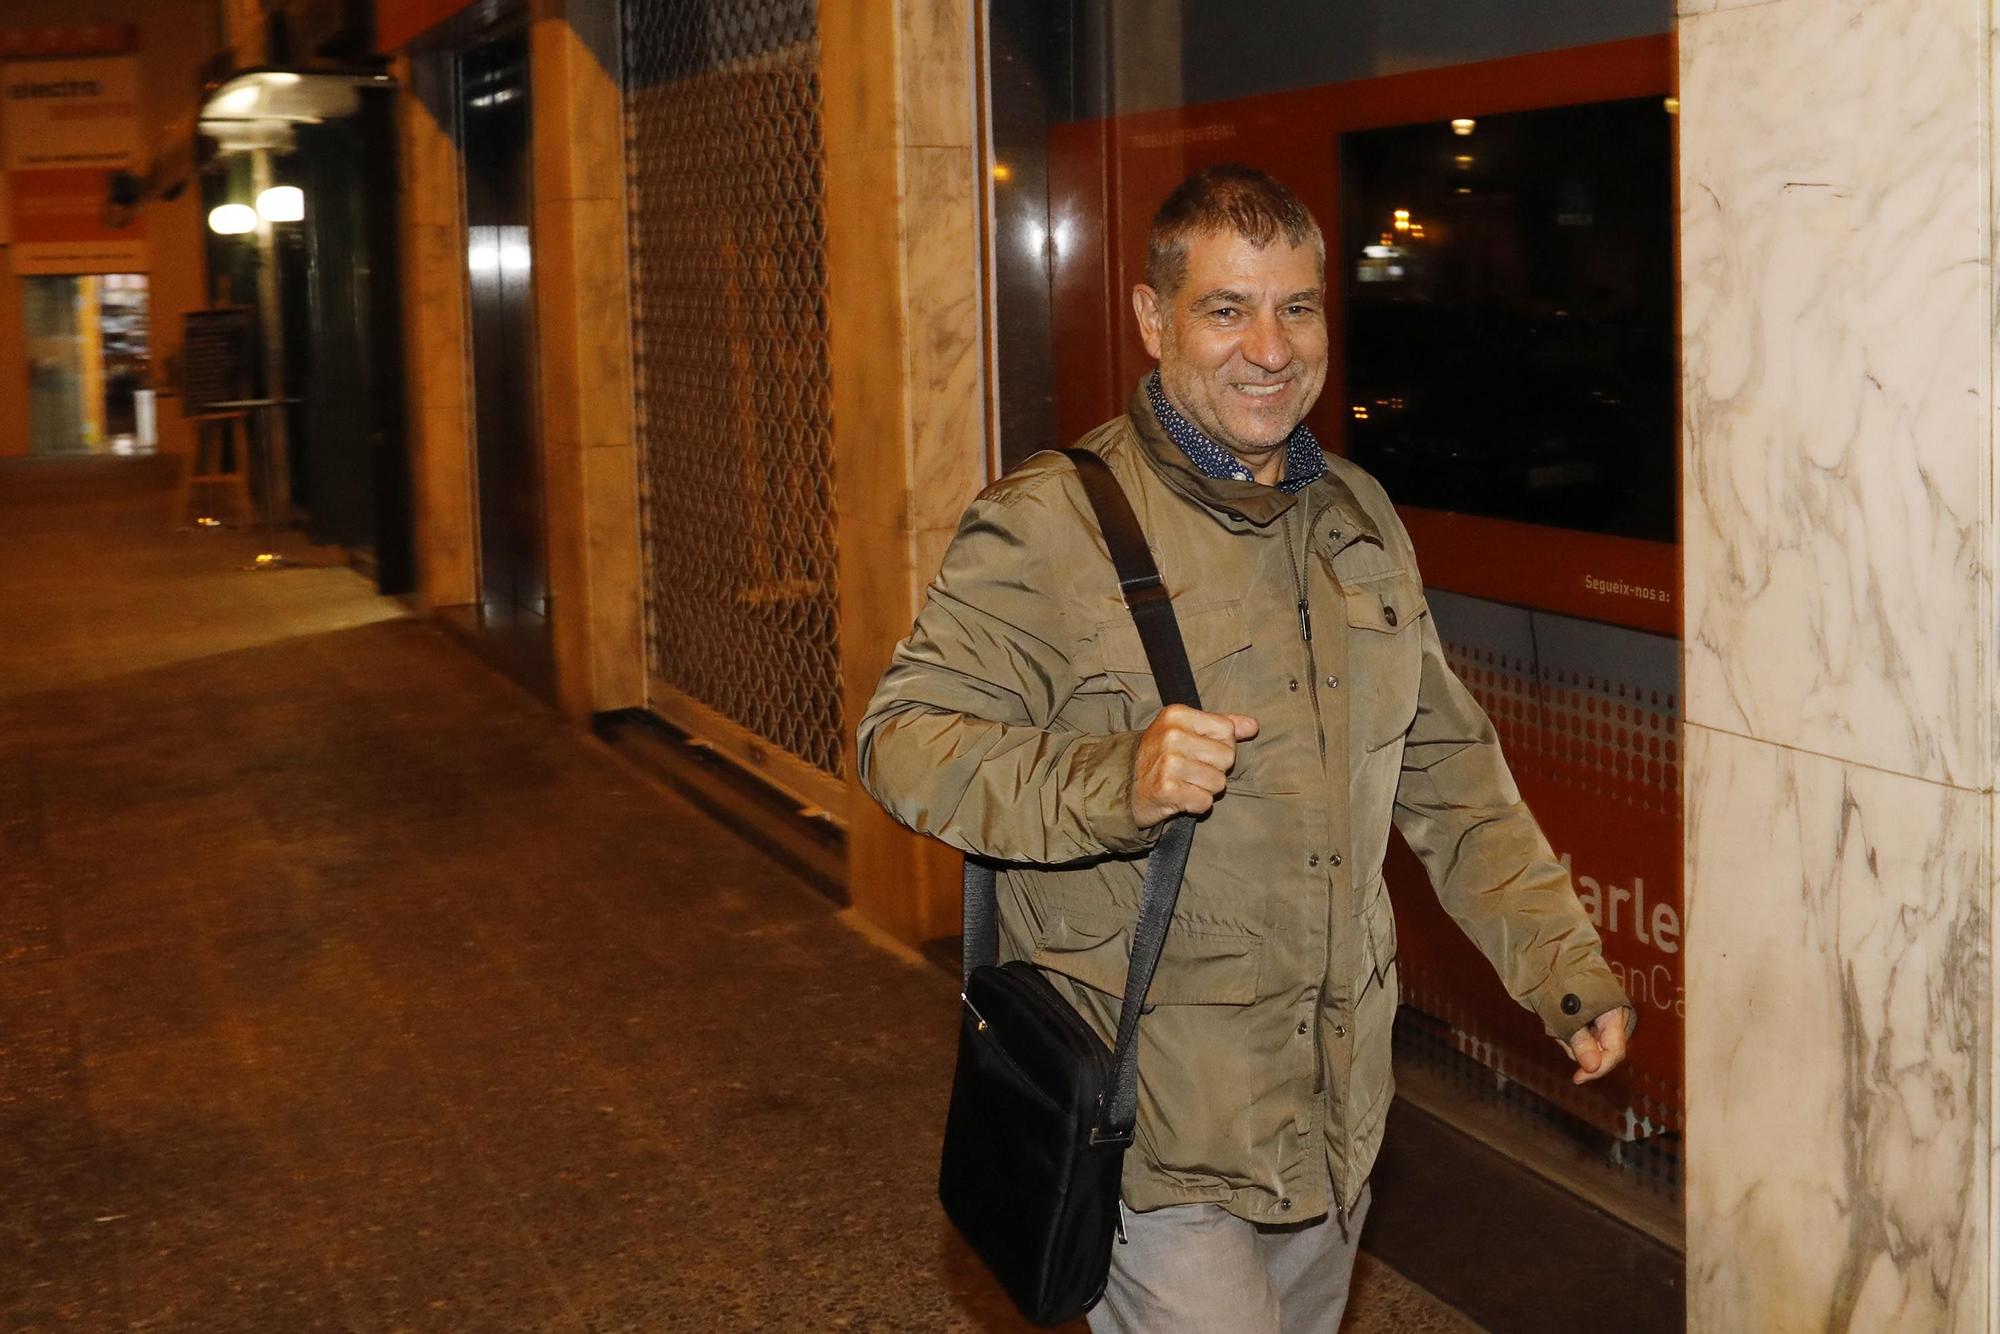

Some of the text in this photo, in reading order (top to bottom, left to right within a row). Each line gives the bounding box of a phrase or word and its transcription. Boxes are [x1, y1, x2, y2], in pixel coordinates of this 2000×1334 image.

[1584, 574, 1670, 603] Segueix-nos a:
[1560, 852, 1680, 954] arle
